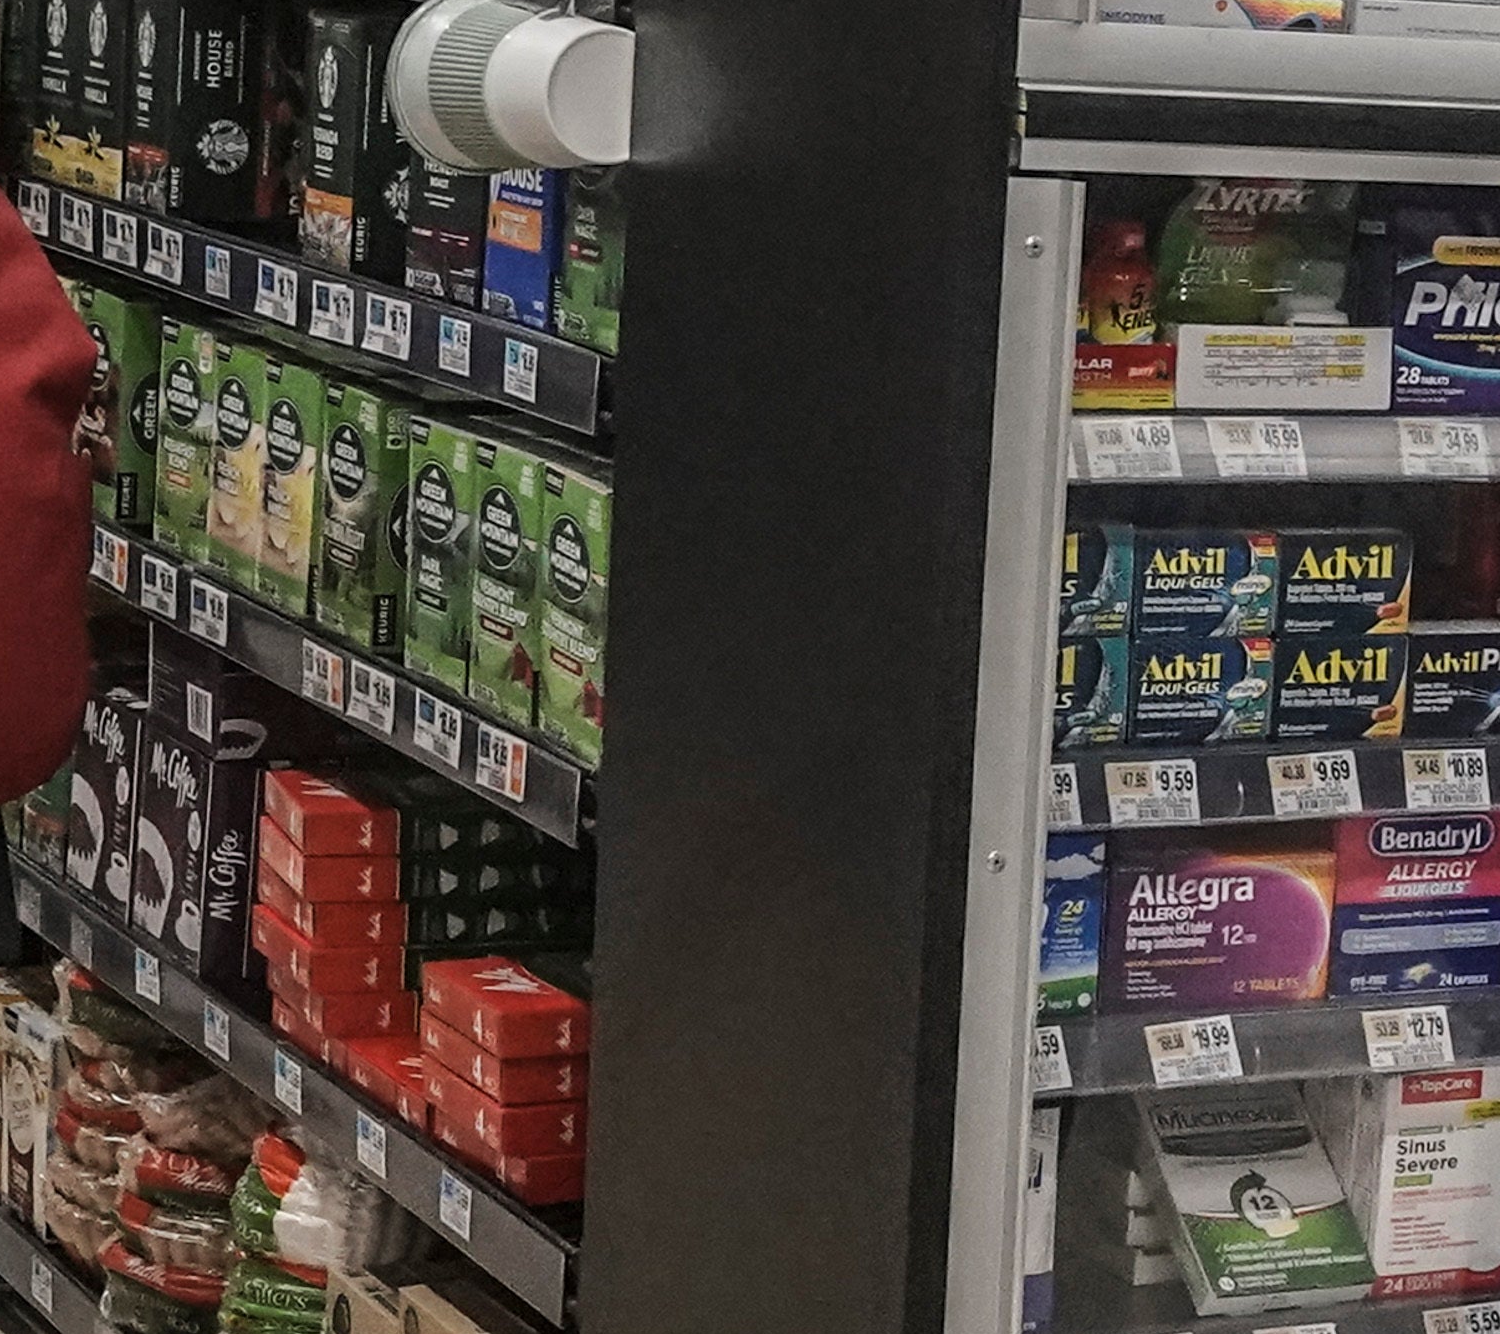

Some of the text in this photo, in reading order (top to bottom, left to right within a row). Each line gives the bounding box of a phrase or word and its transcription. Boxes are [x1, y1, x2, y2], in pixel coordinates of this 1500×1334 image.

[206, 28, 223, 89] HOUSE
[355, 216, 367, 263] KEURIG
[1396, 367, 1420, 386] 28
[144, 389, 157, 441] GREEN
[1144, 547, 1228, 577] Advil
[1291, 545, 1396, 581] Advil
[1145, 575, 1225, 591] LIQUI-GELS
[377, 596, 390, 645] KEURIG
[1140, 653, 1222, 682] Advil
[1285, 648, 1388, 685] Advil
[1417, 649, 1479, 674] Advil
[1140, 680, 1220, 697] LIQUI-GELS
[1155, 770, 1194, 792] $9.59
[1313, 757, 1351, 782] $9.69
[1446, 758, 1484, 779] $10.89
[1381, 822, 1481, 854] Benadryl
[208, 828, 246, 888] Coffee
[1387, 860, 1477, 881] ALLERGY
[1129, 873, 1254, 911] Allegra
[1127, 906, 1197, 922] ALLERGY
[1222, 924, 1244, 946] 12
[1249, 977, 1299, 992] TABLETS
[1407, 1016, 1445, 1038] $12.79
[1420, 1076, 1474, 1093] TopCare
[1396, 1138, 1447, 1155] Sinus
[1395, 1155, 1458, 1174] Severe
[1466, 1308, 1500, 1334] $5.59
